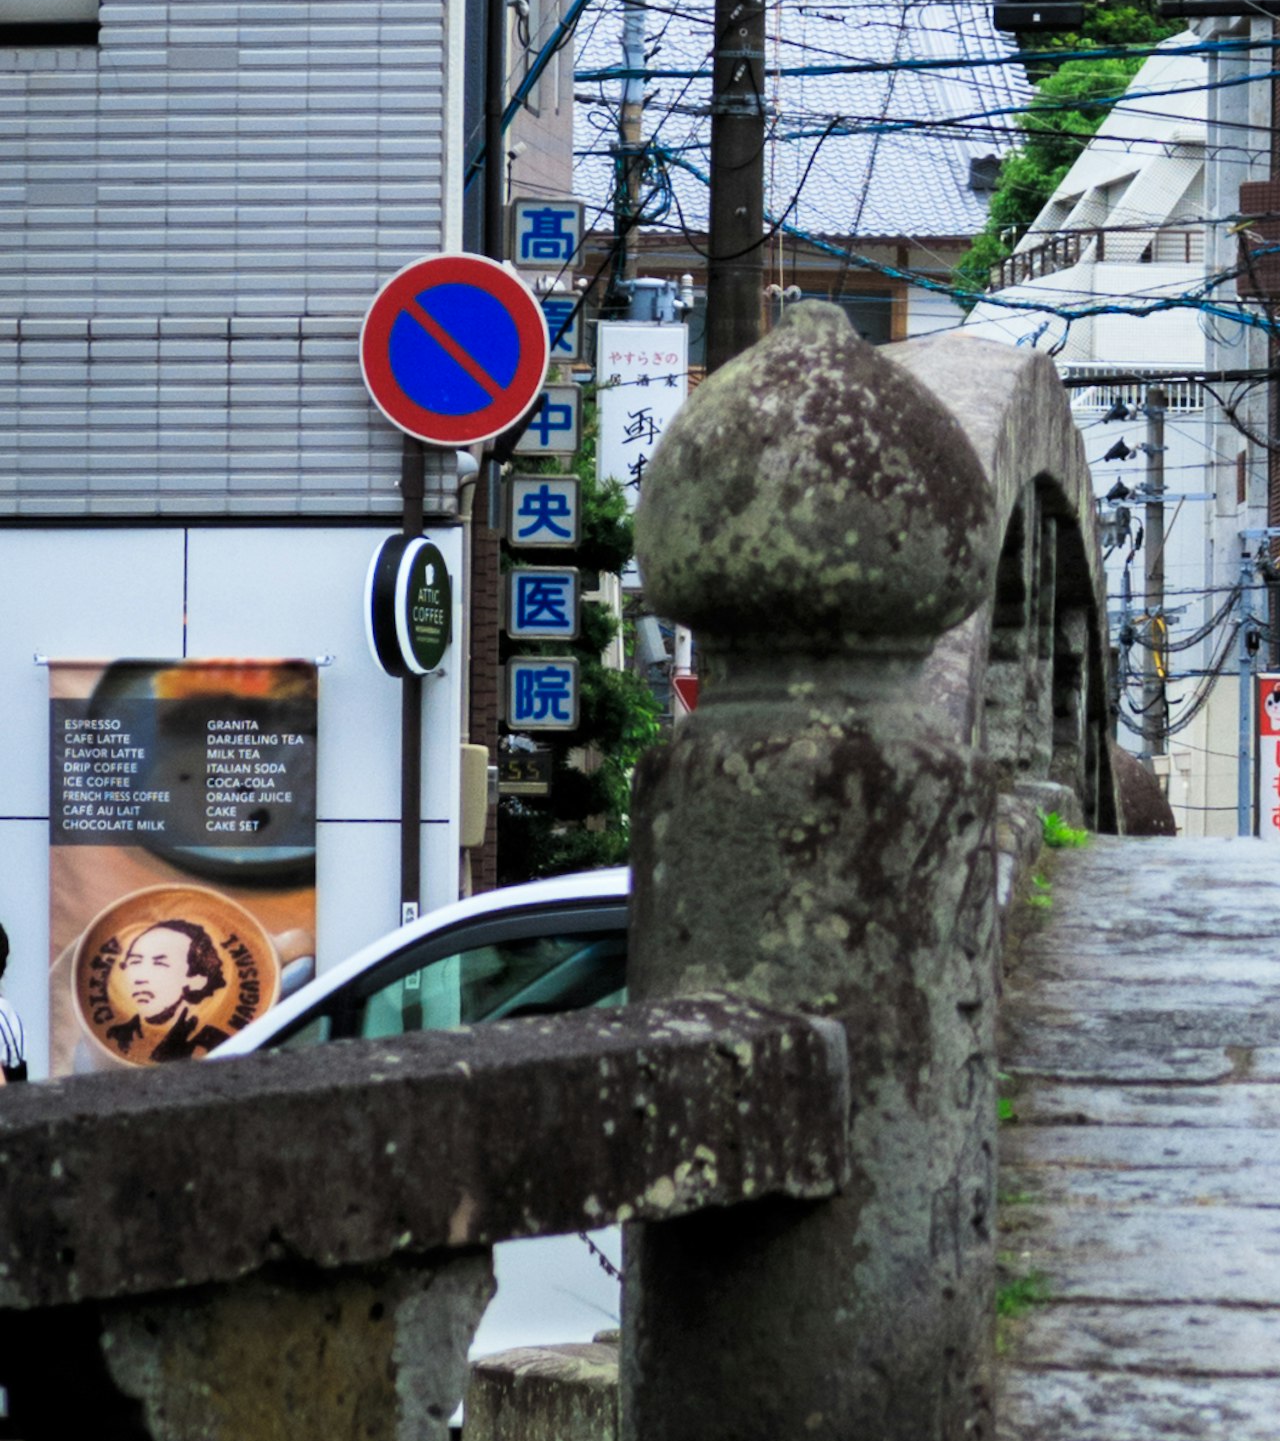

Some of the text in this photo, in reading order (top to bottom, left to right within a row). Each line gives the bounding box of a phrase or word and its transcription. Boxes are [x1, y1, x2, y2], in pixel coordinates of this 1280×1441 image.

[608, 351, 679, 366] やすらぎの
[417, 588, 441, 605] ATTIC
[412, 606, 445, 625] COFFEE
[64, 719, 121, 730] ESPRESSO
[207, 720, 259, 731] GRANITA
[64, 734, 131, 744] CAFE LATTE
[206, 734, 305, 745] DARJEELING TEA
[64, 748, 145, 759] FLAVOR LATTE
[206, 749, 260, 759] MILK TEA
[63, 762, 138, 773] DRIP COFFEE
[206, 763, 287, 774] ITALIAN SODA
[63, 776, 131, 787] ICE COFFEE
[206, 778, 275, 788] COCA-COLA
[63, 791, 171, 802] FRENCH PRESS COFFEE
[206, 792, 293, 803] ORANGE JUICE
[63, 804, 141, 816] CAFÉ AU LAIT
[205, 806, 237, 817] CAKE
[62, 819, 166, 831] CHOCOLATE MILK
[205, 821, 260, 832] CAKE SET
[88, 935, 122, 1025] ATTIC
